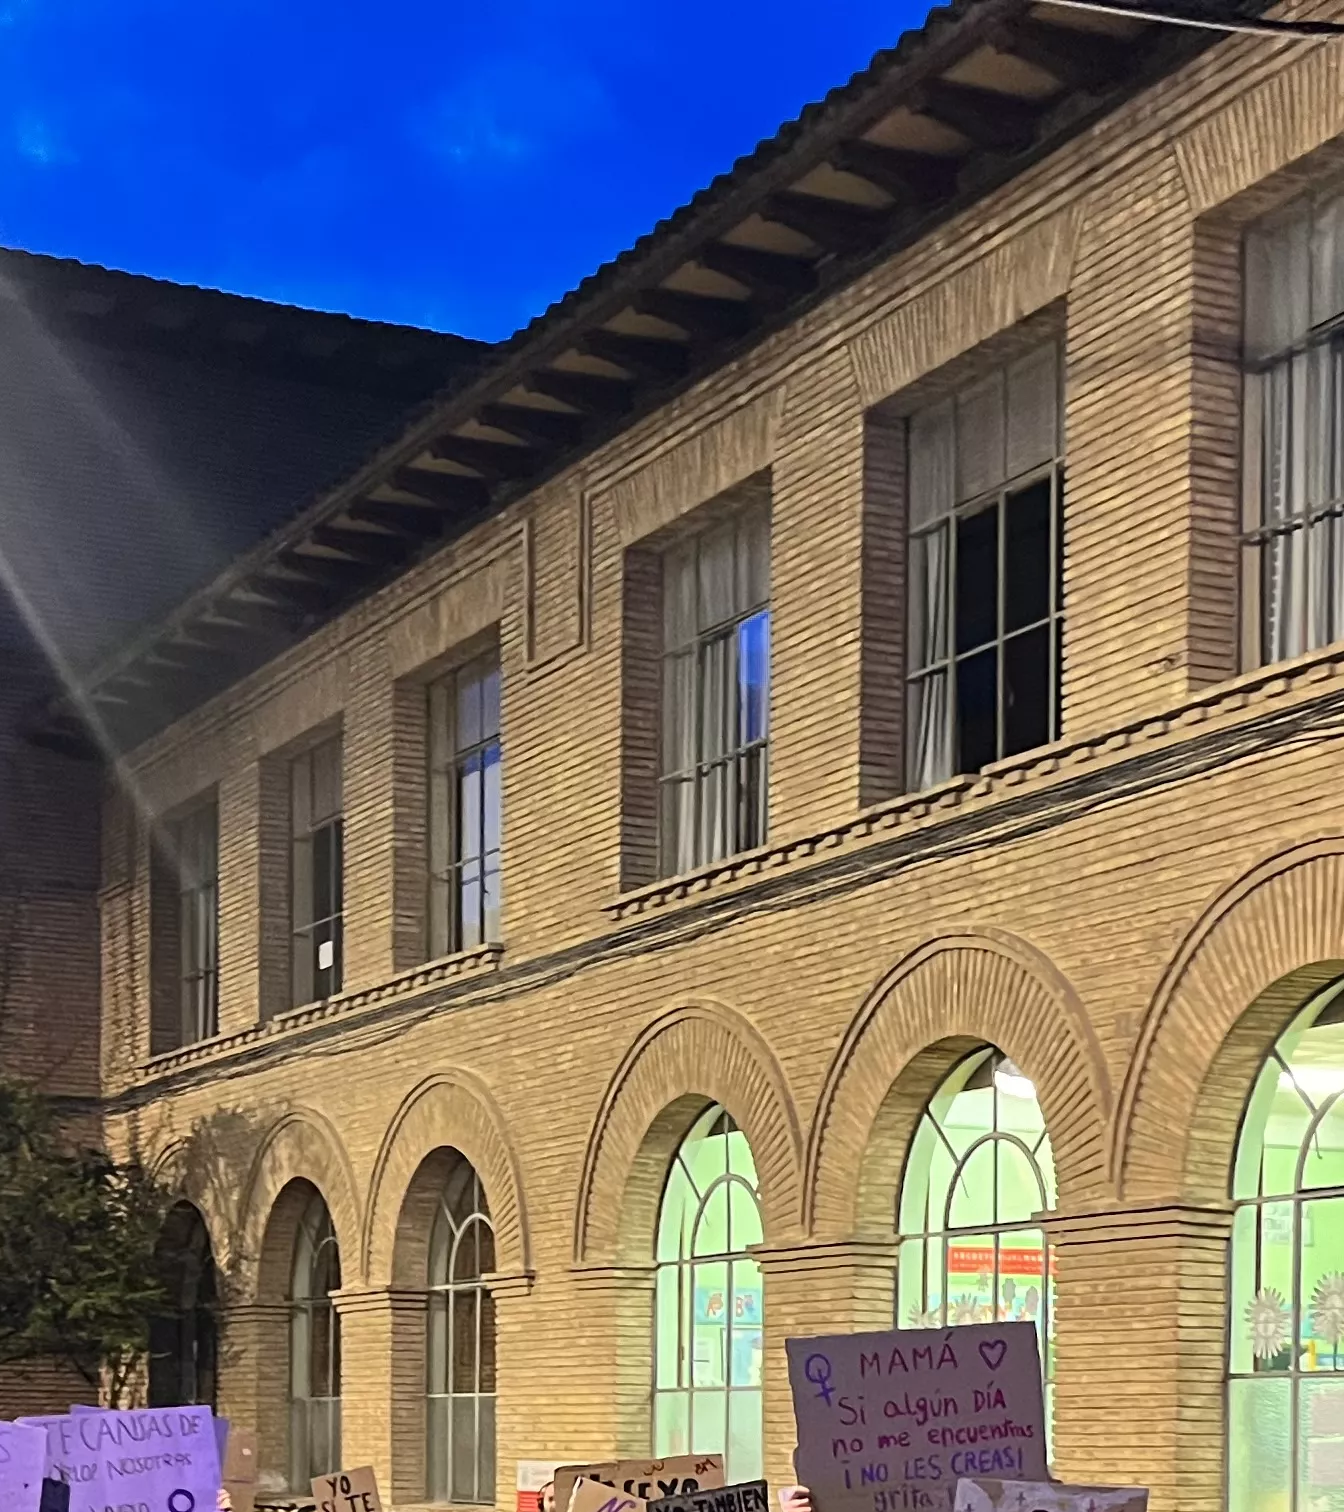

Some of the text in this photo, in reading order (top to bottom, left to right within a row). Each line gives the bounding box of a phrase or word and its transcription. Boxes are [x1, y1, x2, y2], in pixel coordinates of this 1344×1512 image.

[859, 1332, 958, 1378] MAMÁ
[838, 1380, 1007, 1427] Si algún DÍA
[179, 1413, 205, 1437] DE
[832, 1418, 1034, 1459] no me encuentras
[904, 1455, 942, 1480] LES
[951, 1446, 1025, 1477] CREAS!
[325, 1475, 351, 1498] YO
